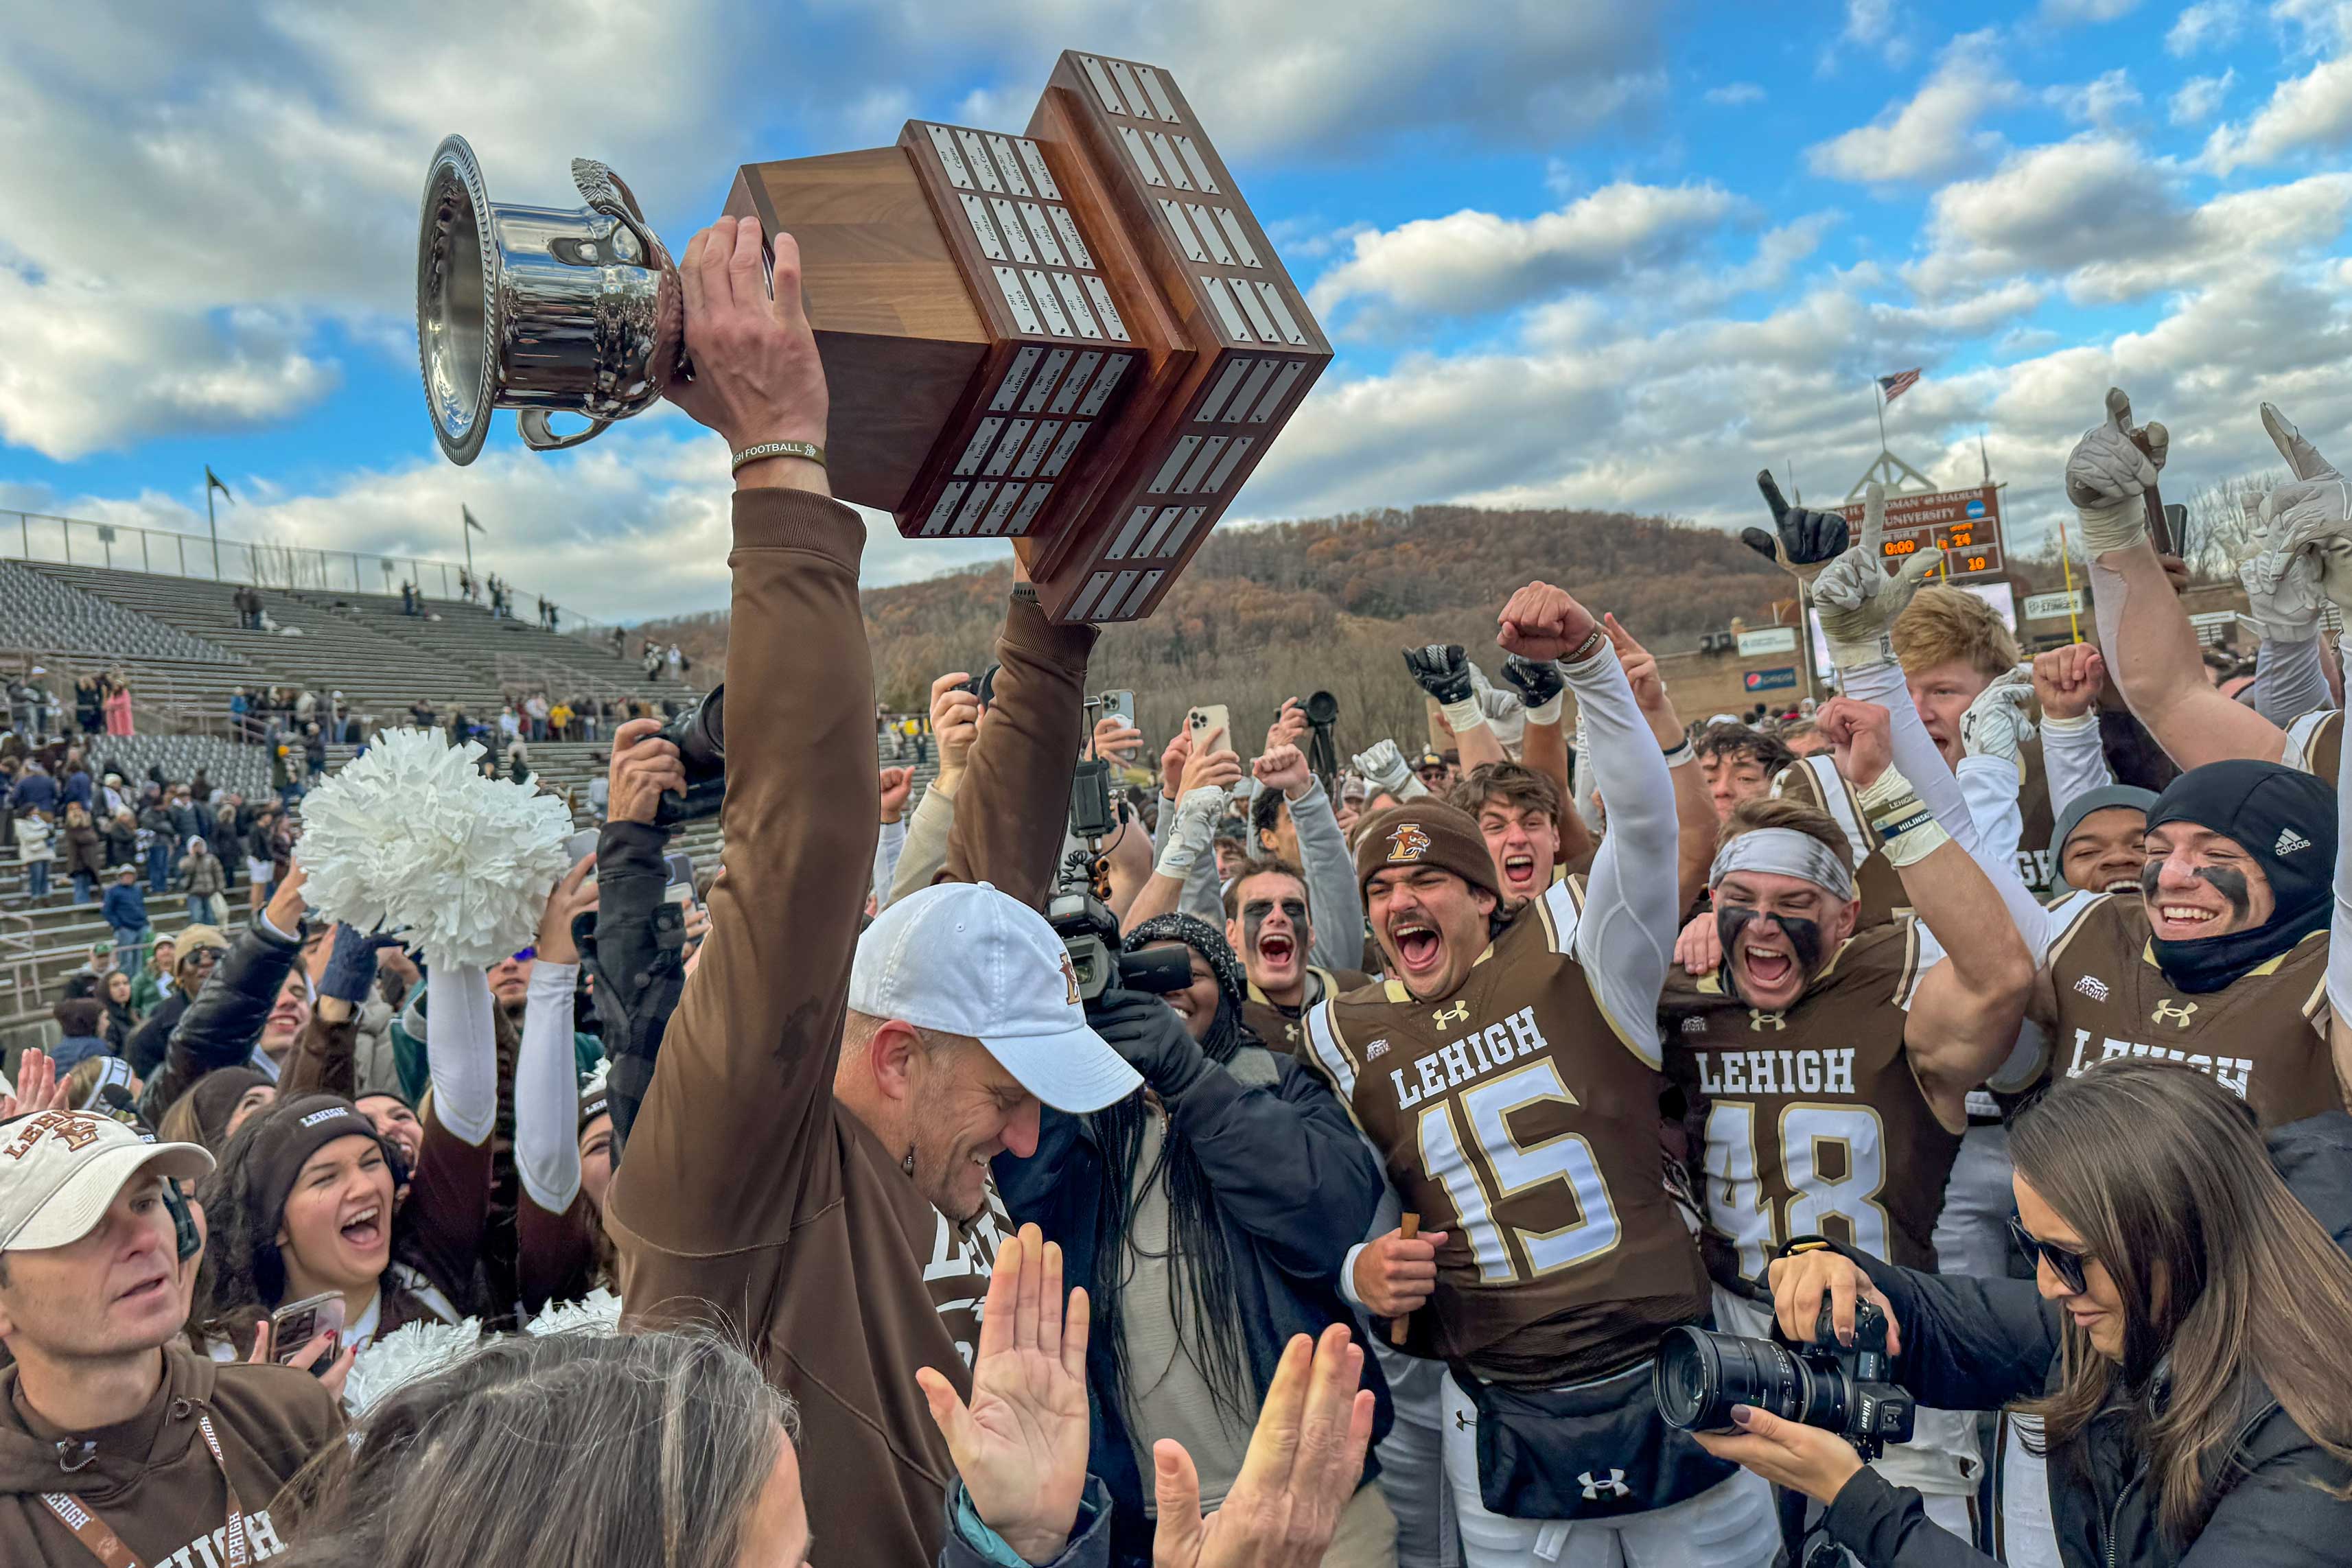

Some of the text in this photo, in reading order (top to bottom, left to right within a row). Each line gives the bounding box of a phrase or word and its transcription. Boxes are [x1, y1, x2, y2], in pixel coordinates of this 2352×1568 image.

[1006, 152, 1023, 182] Holy Cross
[1035, 155, 1052, 185] Holy Cross
[981, 215, 997, 242] Fordham
[1040, 225, 1053, 245] Lehigh
[1016, 290, 1030, 311] Lehigh
[1046, 294, 1060, 314] Lehigh
[1075, 295, 1089, 317] Colgate
[1104, 295, 1119, 323] Lafayette
[1010, 367, 1029, 393] Lafayette
[1040, 368, 1060, 395] Fordham
[1071, 373, 1088, 395] Colgate
[745, 443, 802, 458] FOOTBALL
[1032, 438, 1051, 461] Lafayette
[1935, 488, 1983, 504] STADIUM
[1885, 508, 1955, 527] UNIVERSITY
[1885, 539, 1915, 555] 0:00
[1968, 557, 1986, 571] 10
[2276, 840, 2311, 856] adidas
[1390, 1005, 1548, 1111] LEHIGH
[1695, 1047, 1856, 1095] LEHIGH
[299, 1107, 349, 1127] LEHIGH
[1417, 1055, 1622, 1283] 15
[1703, 1099, 1890, 1281] 48
[1861, 1399, 1872, 1430] Nikon
[199, 1415, 224, 1462] LEHIGH
[229, 1510, 246, 1567] LEHIGH
